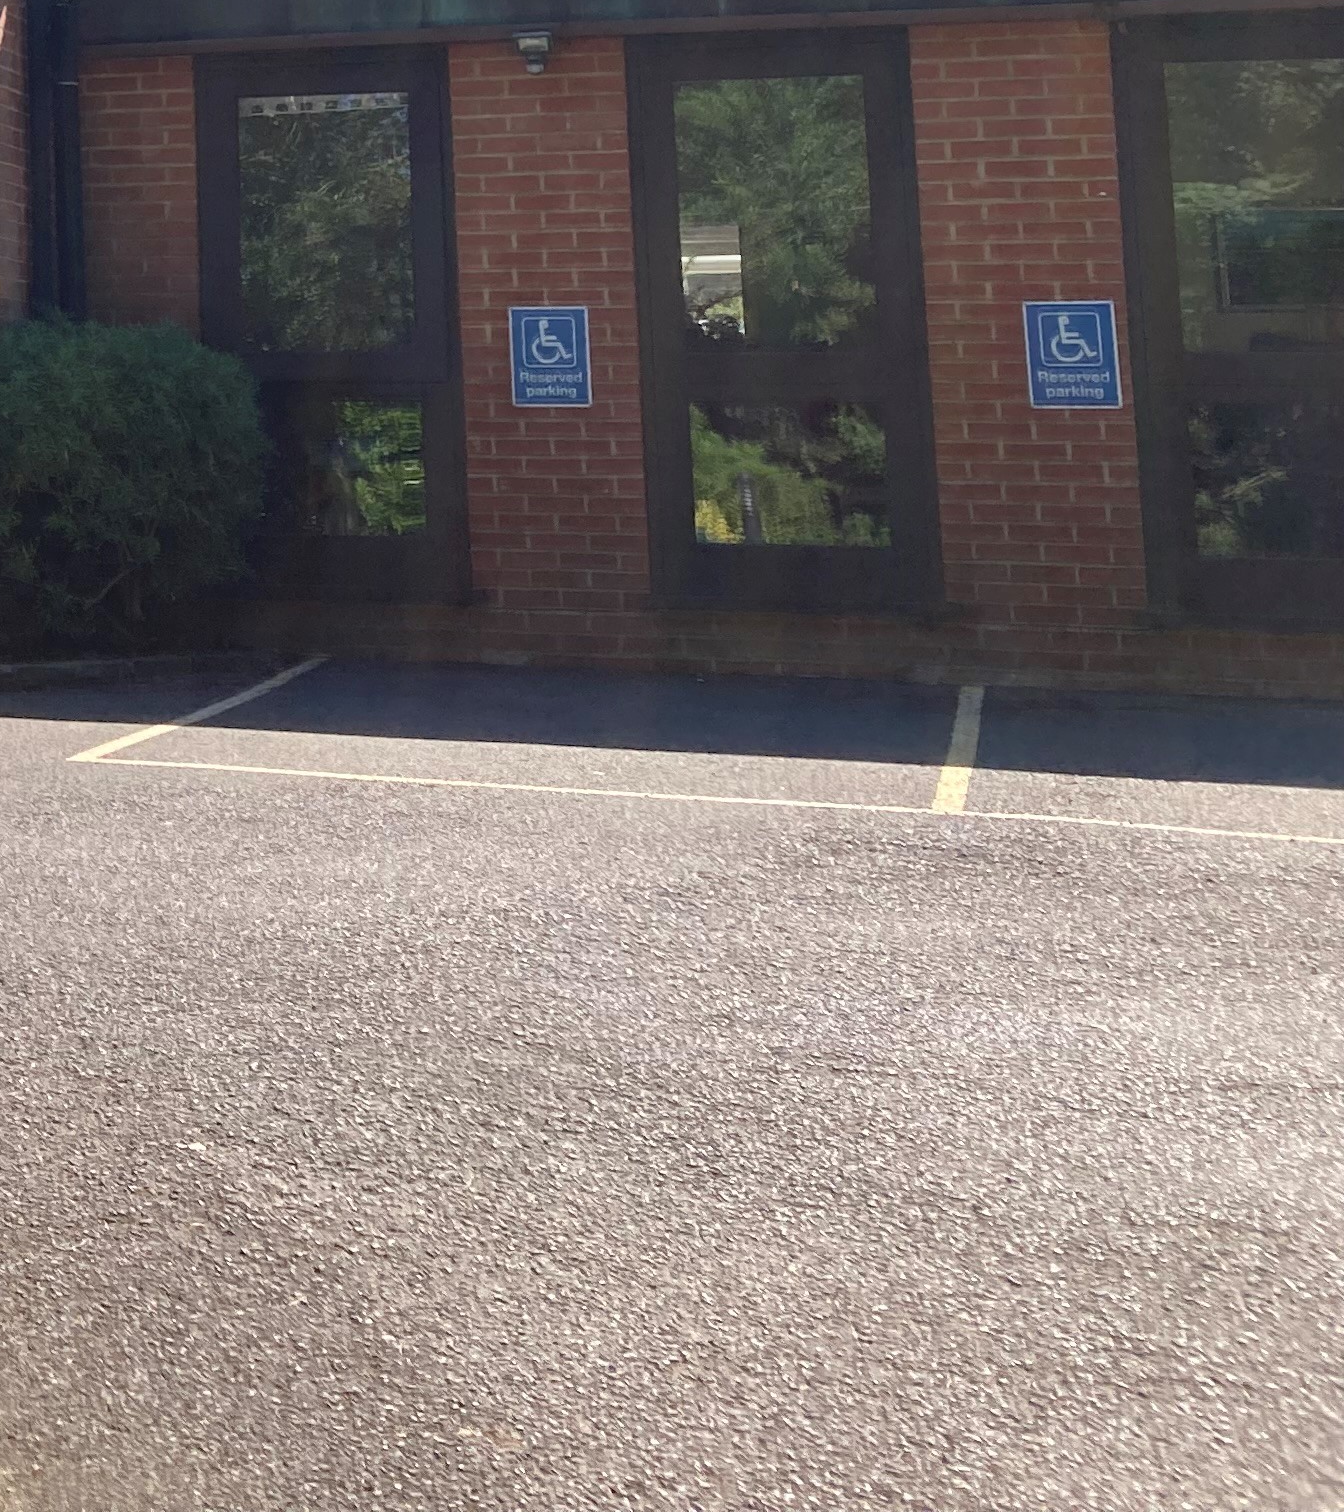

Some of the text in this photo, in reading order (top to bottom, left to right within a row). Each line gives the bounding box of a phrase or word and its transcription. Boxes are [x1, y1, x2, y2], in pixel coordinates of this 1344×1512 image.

[520, 371, 583, 383] Reserved
[1038, 371, 1110, 383] Reserved
[526, 385, 577, 398] parking
[1046, 385, 1104, 399] parking
